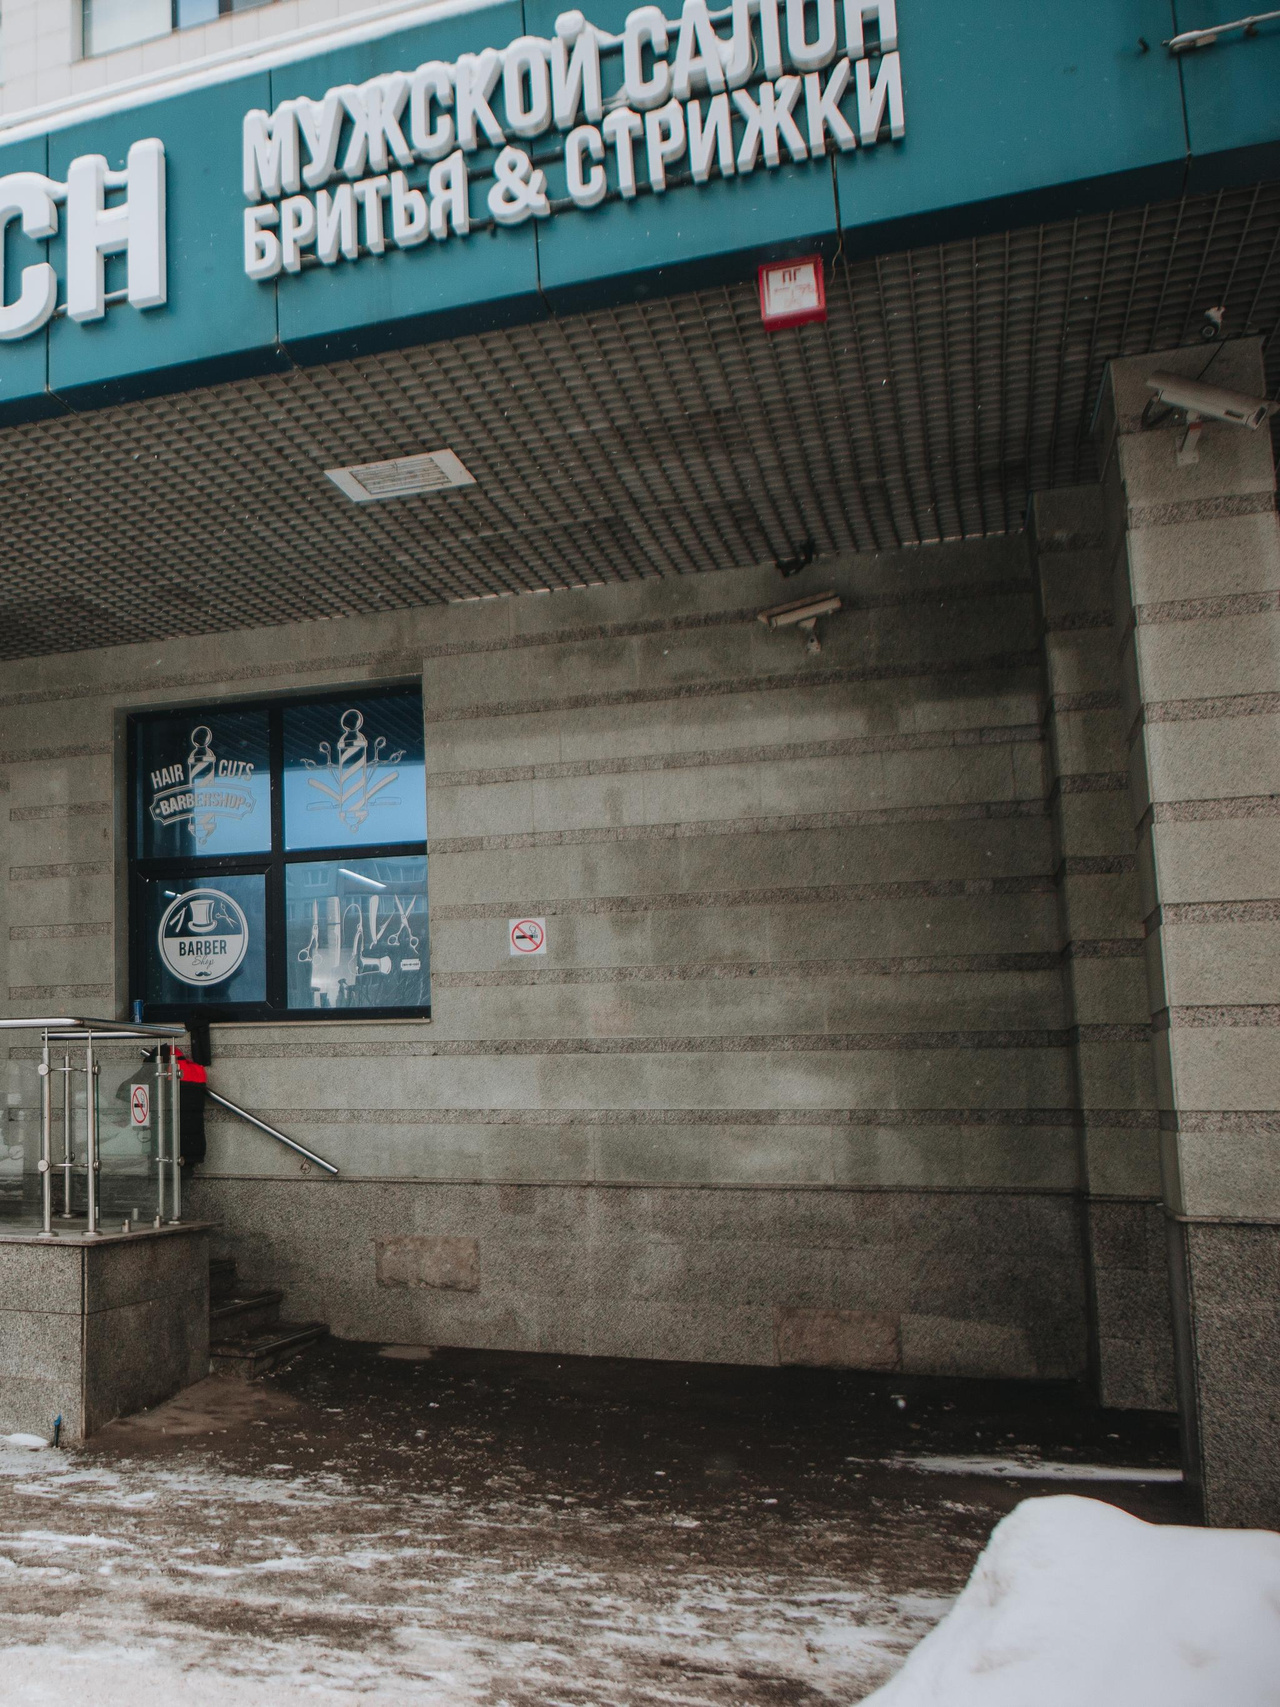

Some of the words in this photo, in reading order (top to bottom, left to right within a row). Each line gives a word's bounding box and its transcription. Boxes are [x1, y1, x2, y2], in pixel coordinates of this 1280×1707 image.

[242, 9, 602, 202] МУЖСКОЙ
[623, 0, 900, 110] САЛОН
[243, 149, 471, 280] БРИТЬЯ
[487, 145, 551, 226] &
[565, 50, 906, 209] СТРИЖКИ
[150, 763, 185, 789] HAIR
[218, 759, 255, 782] CUTS
[159, 791, 247, 816] BARBERSHOP
[179, 939, 227, 957] BARBER
[191, 954, 215, 970] Shop
